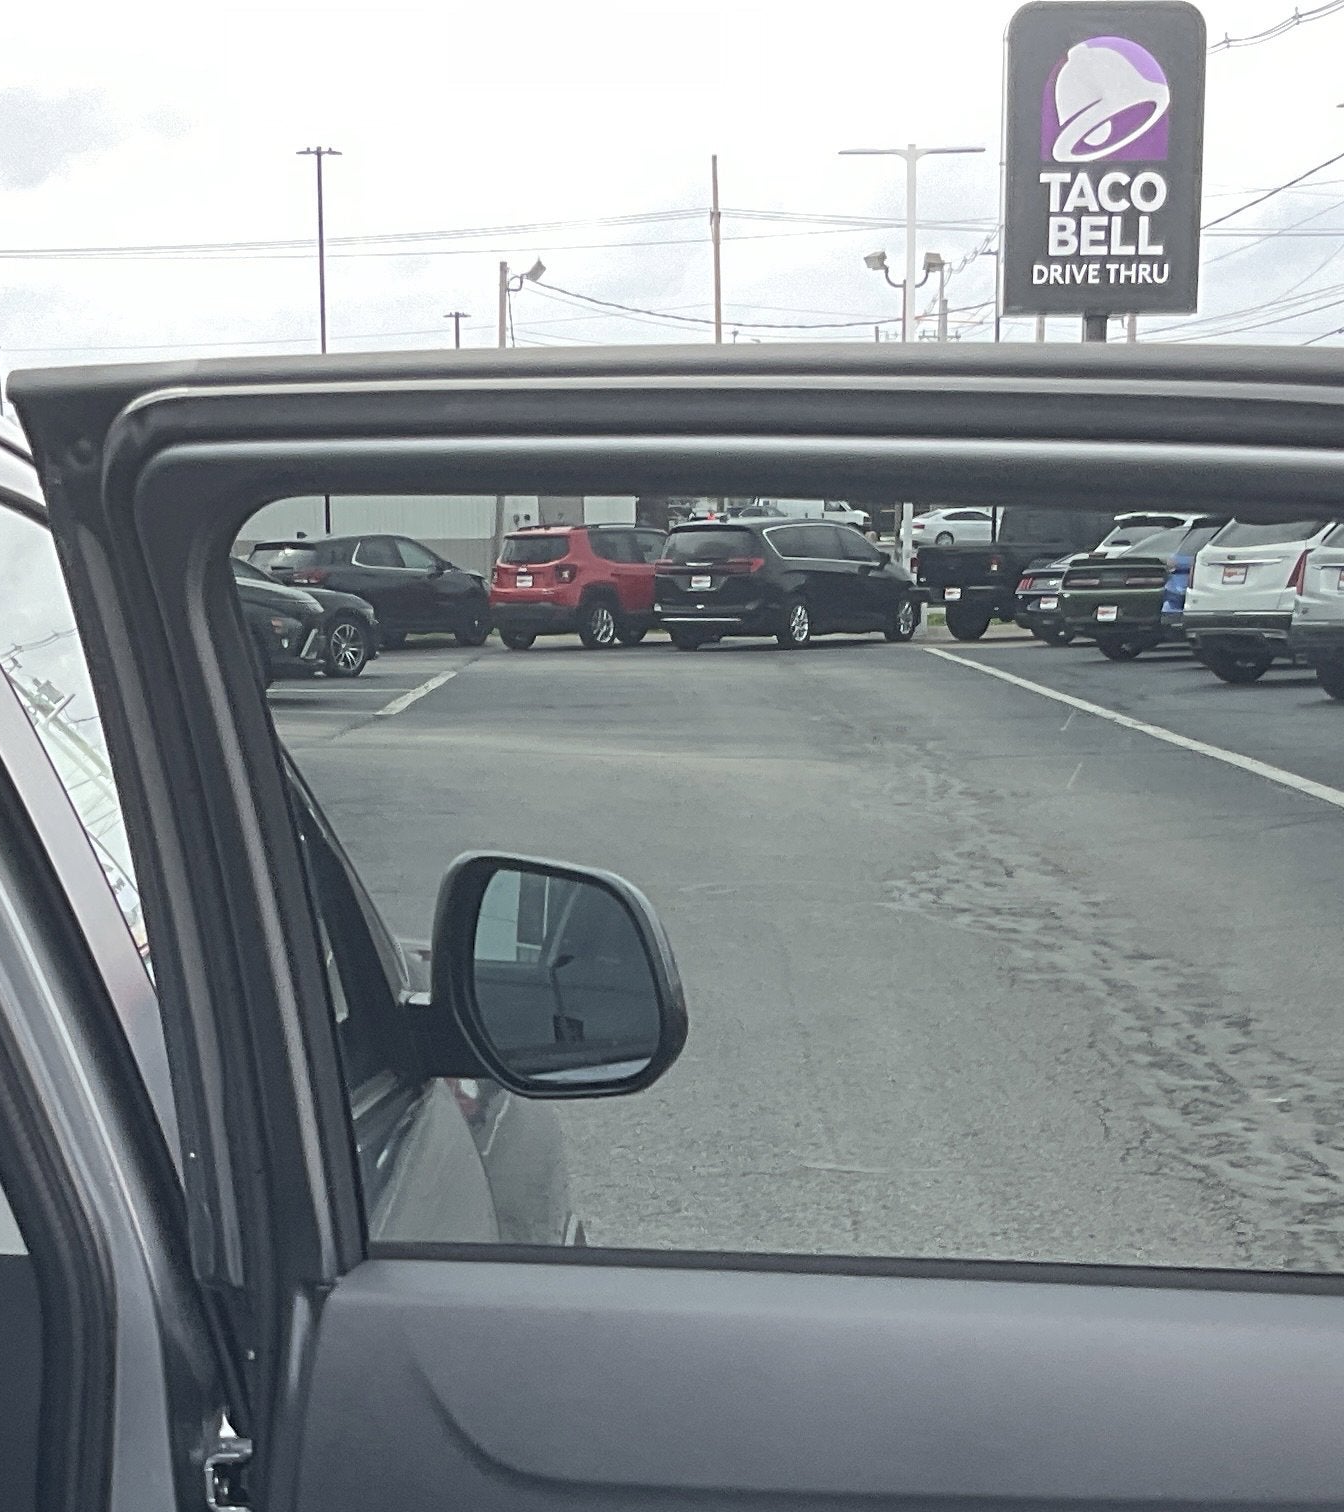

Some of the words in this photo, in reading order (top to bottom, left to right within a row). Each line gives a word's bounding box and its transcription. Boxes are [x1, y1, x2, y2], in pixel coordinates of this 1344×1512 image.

[1040, 171, 1167, 212] TACO
[1049, 215, 1163, 256] BELL
[1032, 263, 1101, 285] DRIVE
[1105, 263, 1169, 284] THRU
